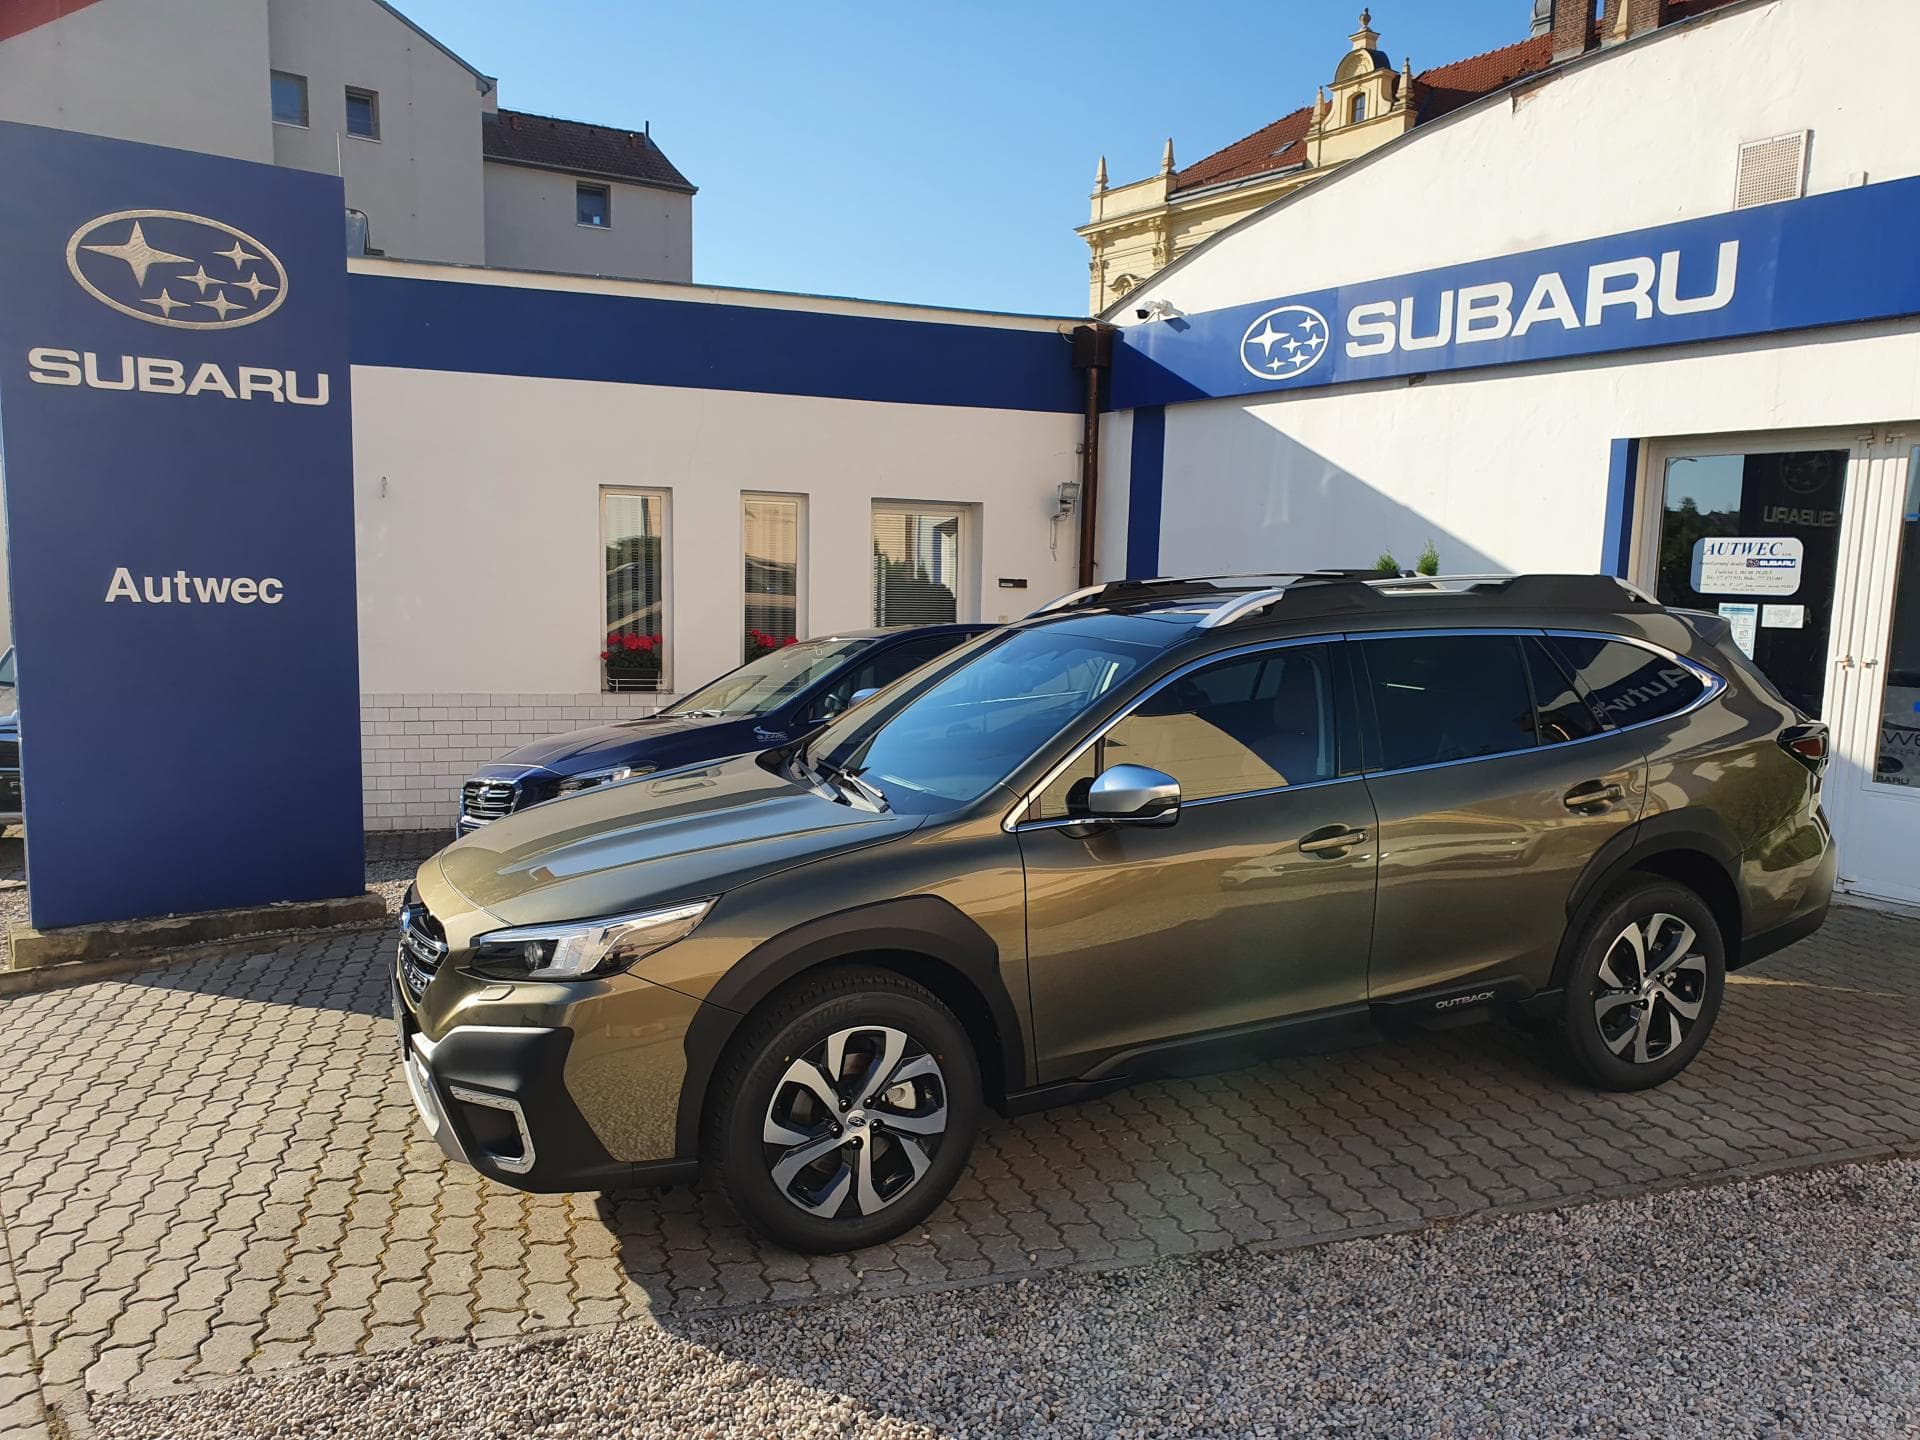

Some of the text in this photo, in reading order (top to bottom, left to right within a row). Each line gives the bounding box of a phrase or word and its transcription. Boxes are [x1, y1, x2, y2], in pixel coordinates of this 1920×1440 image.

[1345, 240, 1739, 358] SUBARU
[28, 347, 329, 406] SUBARU
[1704, 542, 1782, 556] AUTWEC
[104, 567, 284, 604] Autwec
[1435, 991, 1496, 1009] OUTBACK
